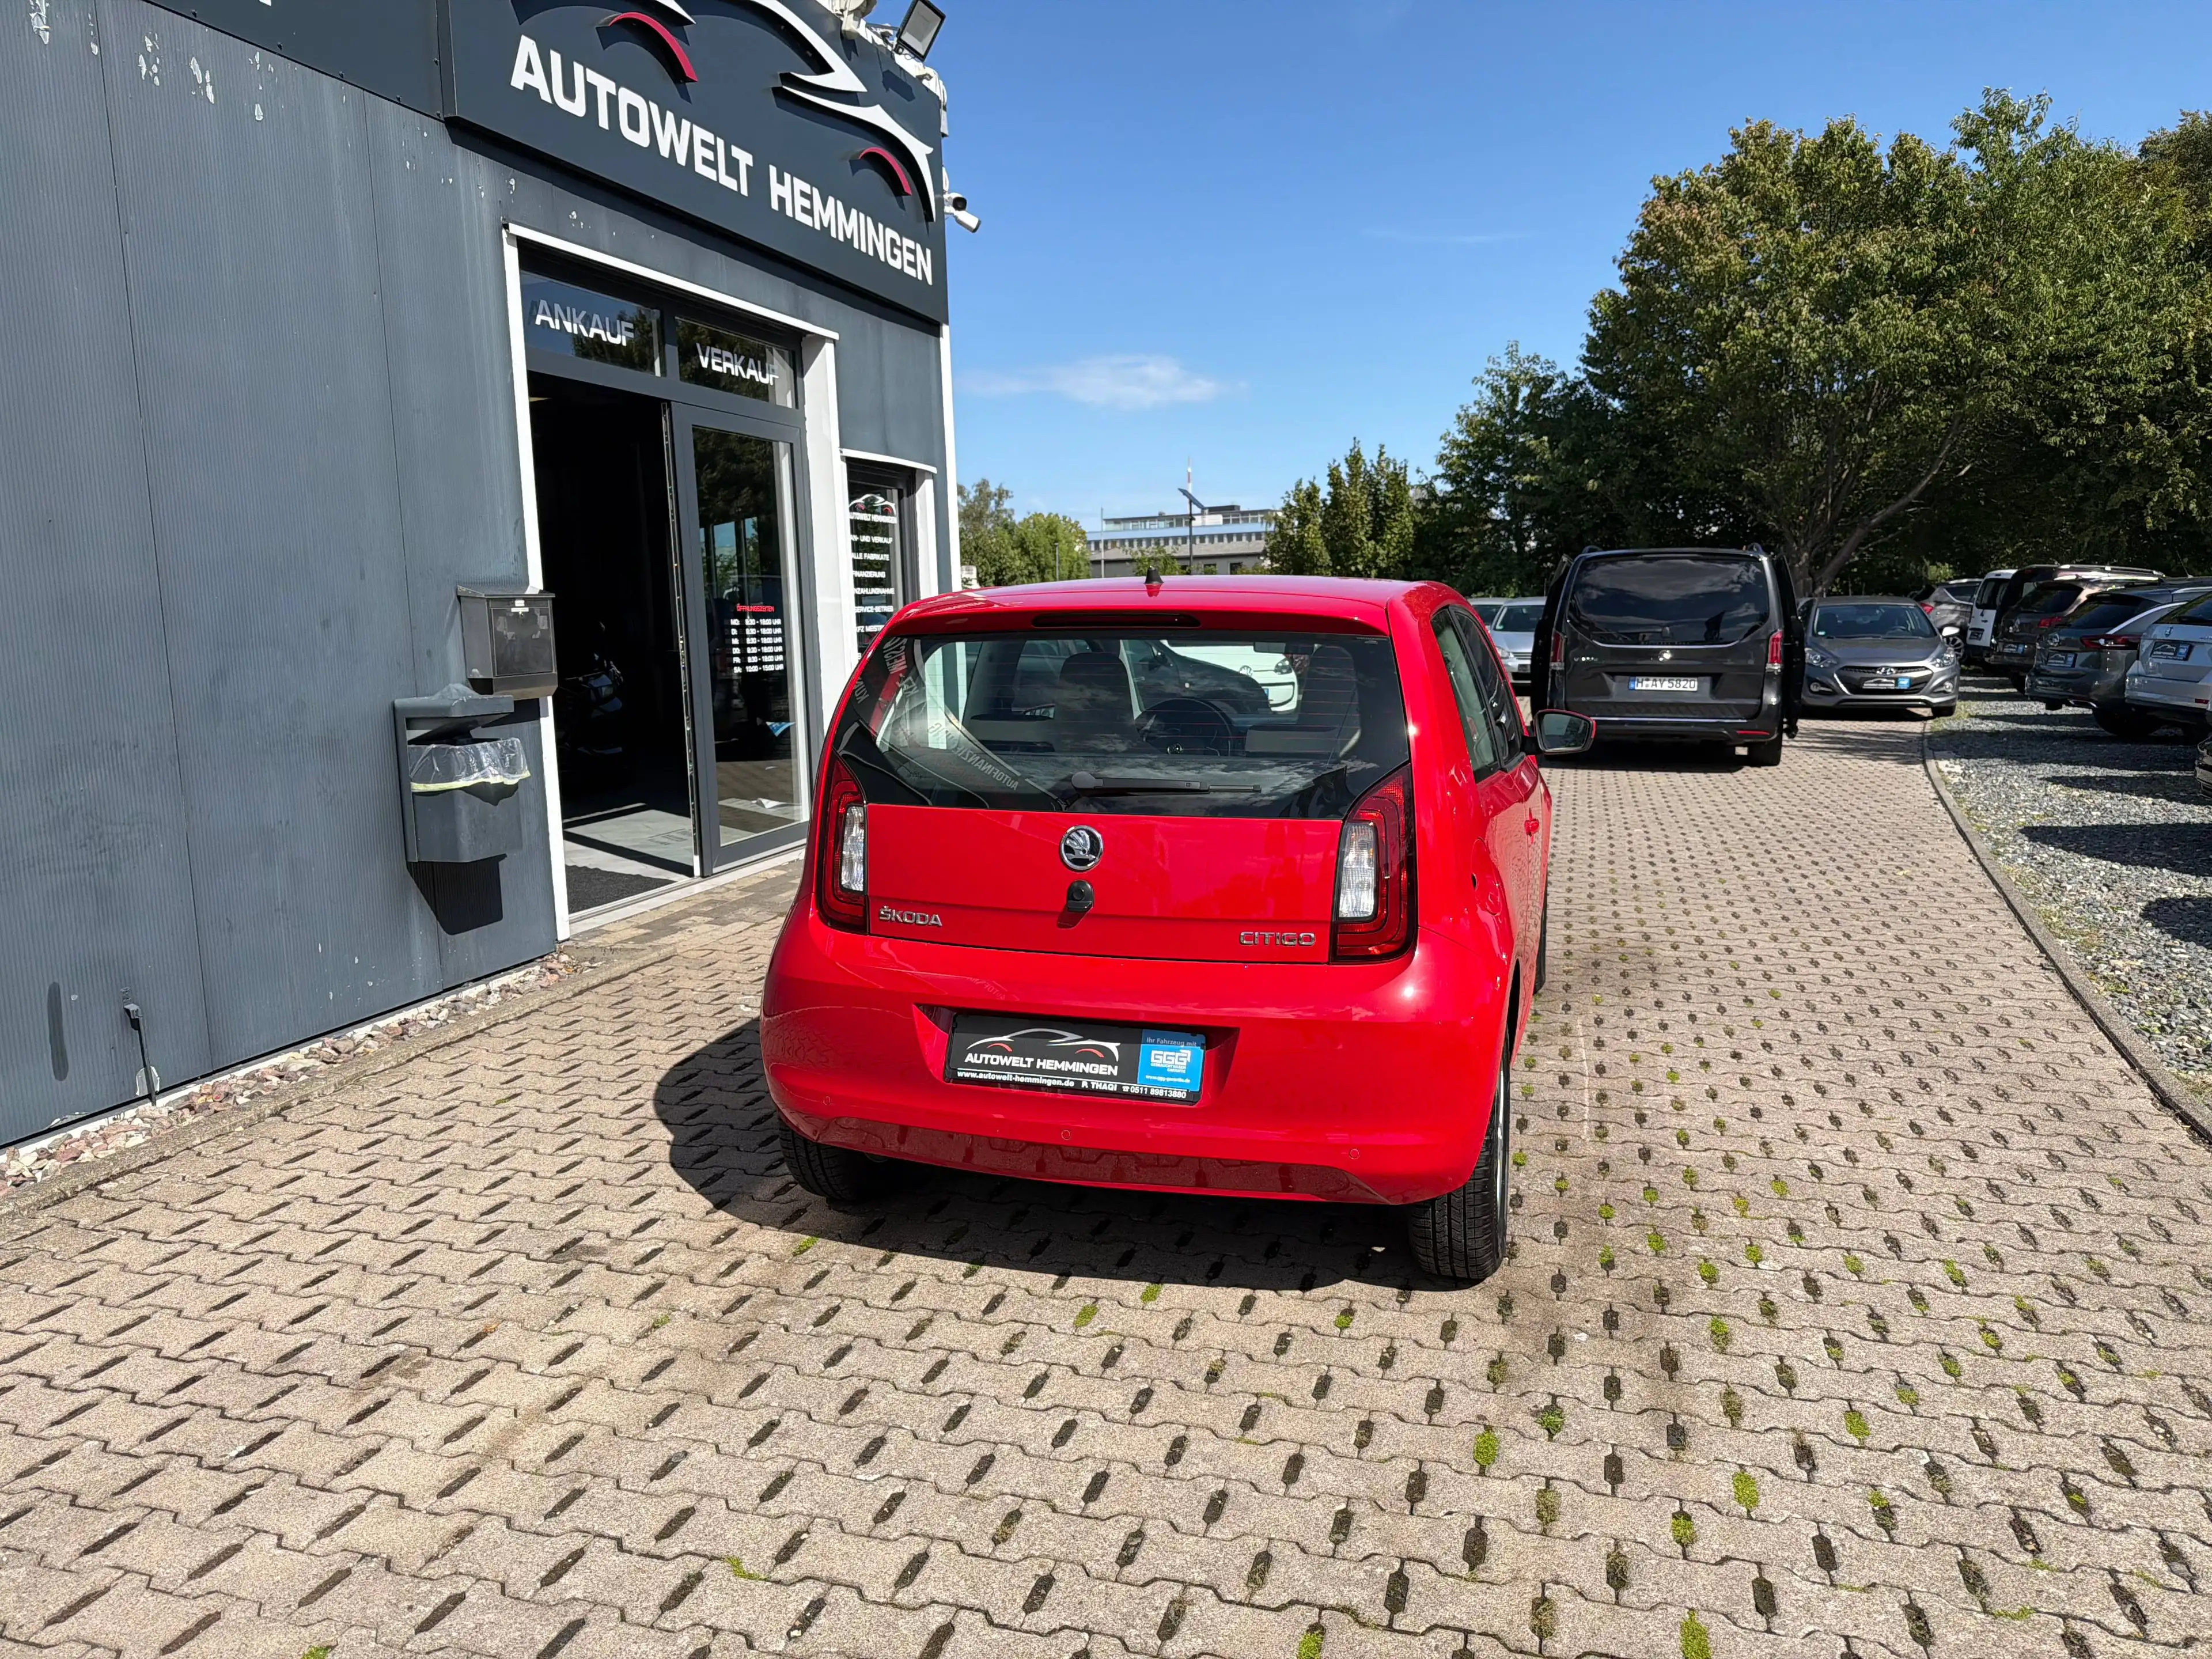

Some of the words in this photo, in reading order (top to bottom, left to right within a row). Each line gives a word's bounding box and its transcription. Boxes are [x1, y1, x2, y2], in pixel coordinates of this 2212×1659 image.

[510, 35, 753, 196] AUTOWELT
[769, 165, 933, 286] HEMMINGEN
[535, 299, 634, 346] ANKAUF
[695, 343, 779, 385] VERKAUF
[864, 553, 889, 561] FABRIKATE
[1637, 678, 1643, 688] H
[1651, 679, 1666, 688] AY
[1668, 679, 1696, 688] 5820
[879, 906, 942, 926] ŠKODA
[1240, 931, 1316, 946] CITIGO
[1157, 1038, 1185, 1047] Fahrzeug
[964, 1052, 1035, 1069] AUTOWELT
[1036, 1059, 1118, 1076] HEMMINGEN
[1151, 1050, 1190, 1065] GGG
[957, 1070, 1075, 1087] www.autowelt-hemmingen.de
[1090, 1081, 1118, 1092] THAQI
[1130, 1086, 1148, 1094] 0511
[1150, 1089, 1187, 1099] 89813880
